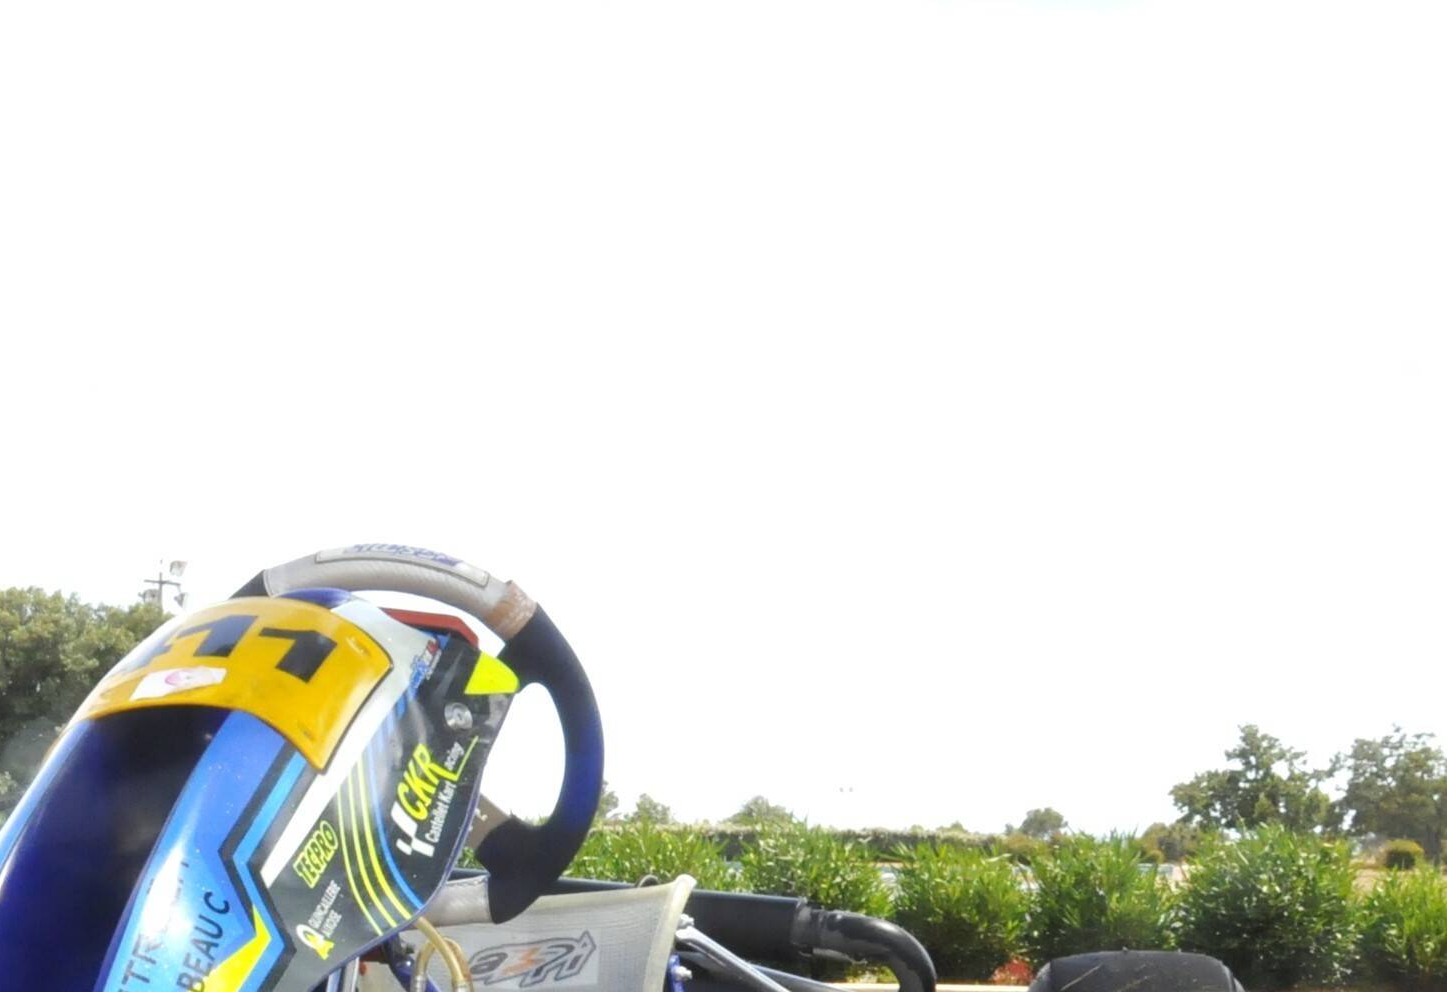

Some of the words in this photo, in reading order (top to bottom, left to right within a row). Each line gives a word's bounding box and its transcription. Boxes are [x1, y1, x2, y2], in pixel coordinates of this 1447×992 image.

[397, 742, 458, 822] CKR
[437, 780, 458, 804] Kart
[293, 820, 338, 888] TECPRO
